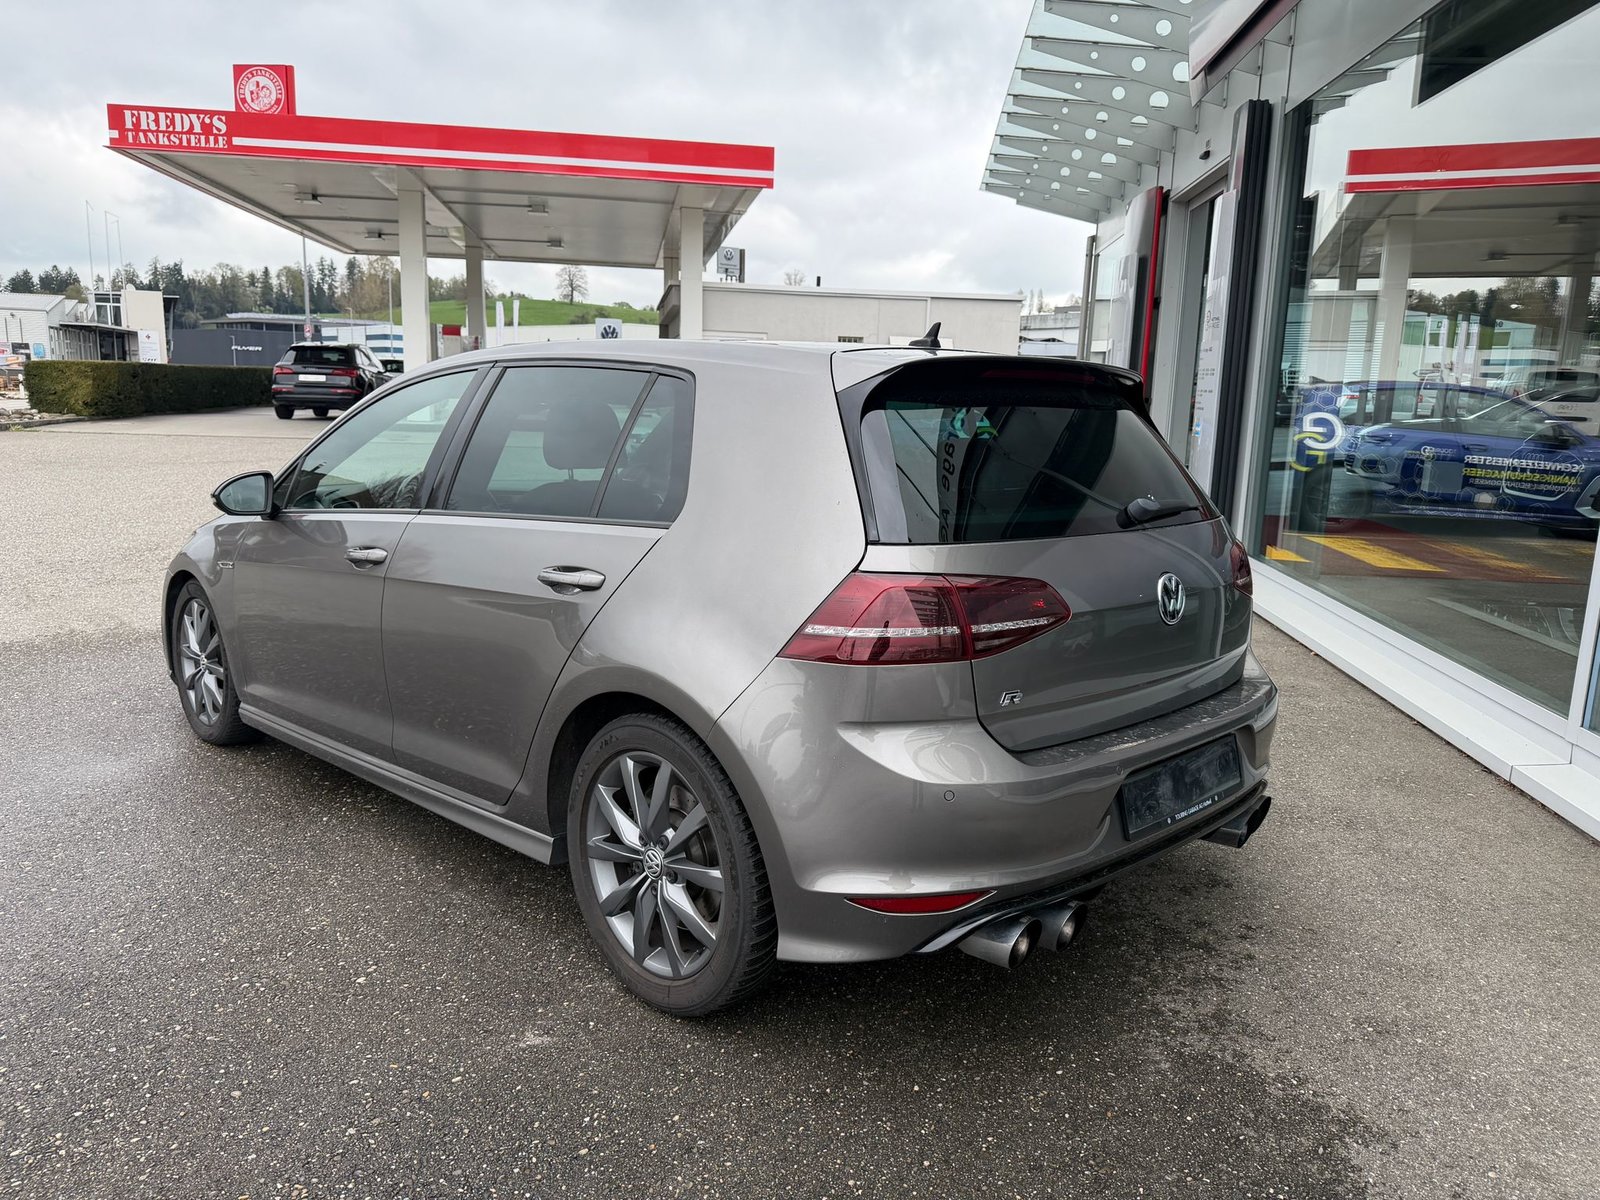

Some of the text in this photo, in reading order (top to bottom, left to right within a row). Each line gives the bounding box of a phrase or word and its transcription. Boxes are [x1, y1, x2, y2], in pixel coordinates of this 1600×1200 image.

[252, 69, 282, 99] TANKSTELLE
[123, 110, 227, 134] FREDY'S
[125, 131, 228, 149] TANKSTELLE
